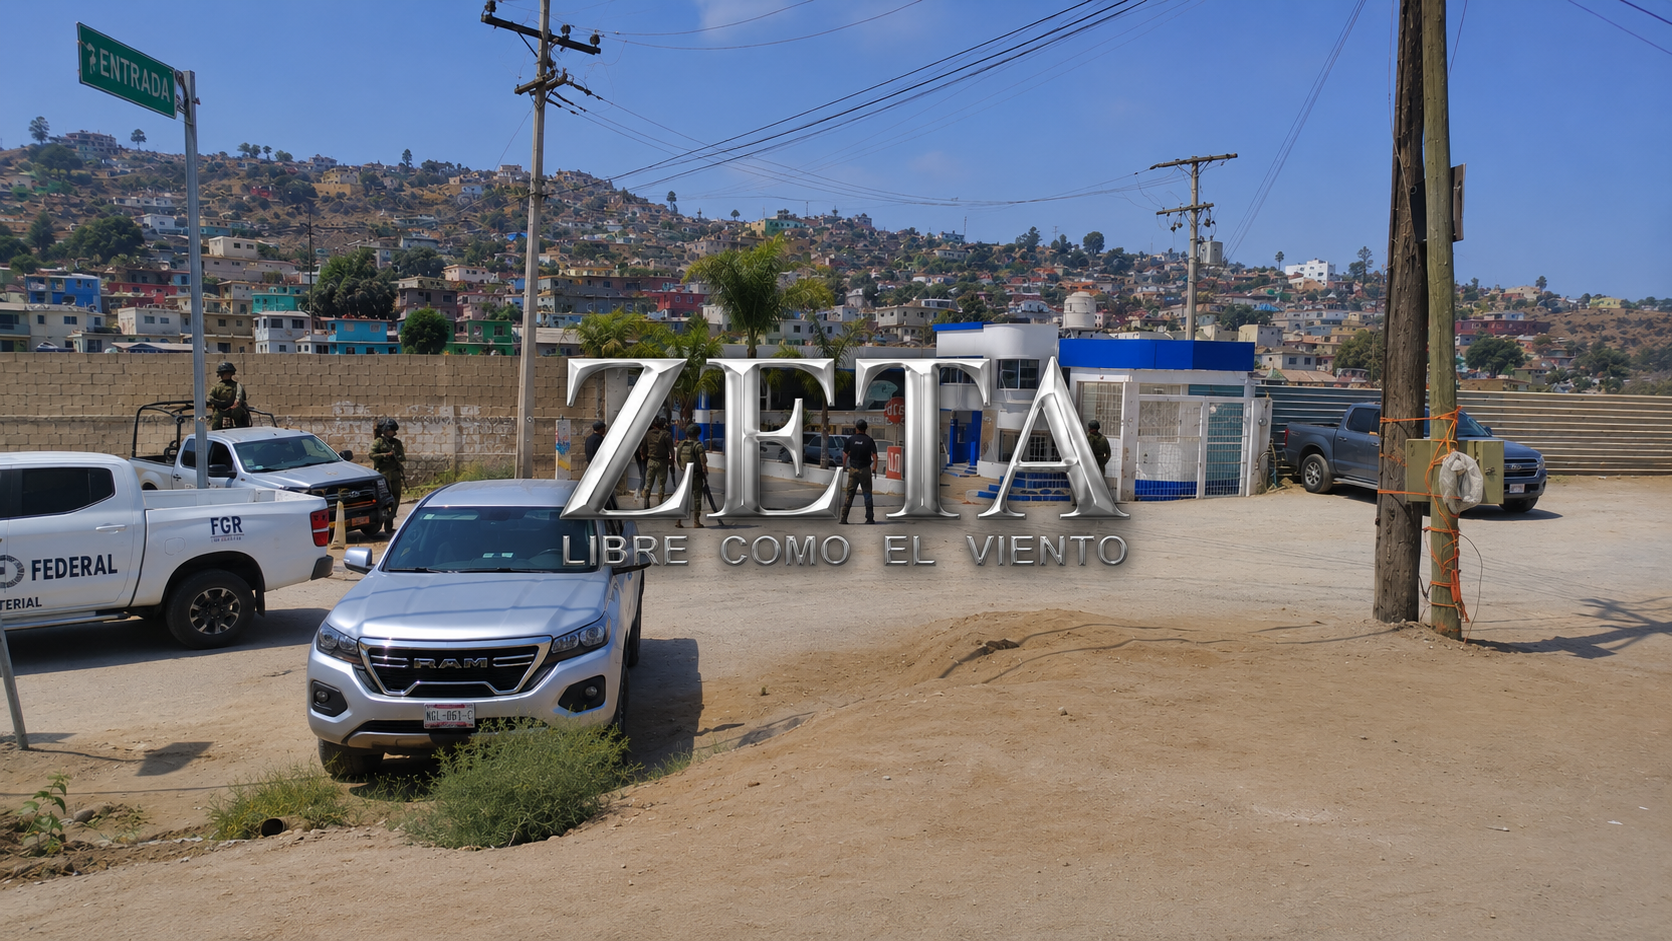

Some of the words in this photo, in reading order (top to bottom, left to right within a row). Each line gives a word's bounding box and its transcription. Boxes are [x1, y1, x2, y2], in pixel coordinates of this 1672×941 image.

[99, 47, 171, 103] ENTRADA
[210, 516, 243, 535] FGR
[31, 553, 118, 581] FEDERAL
[413, 657, 488, 669] RAM
